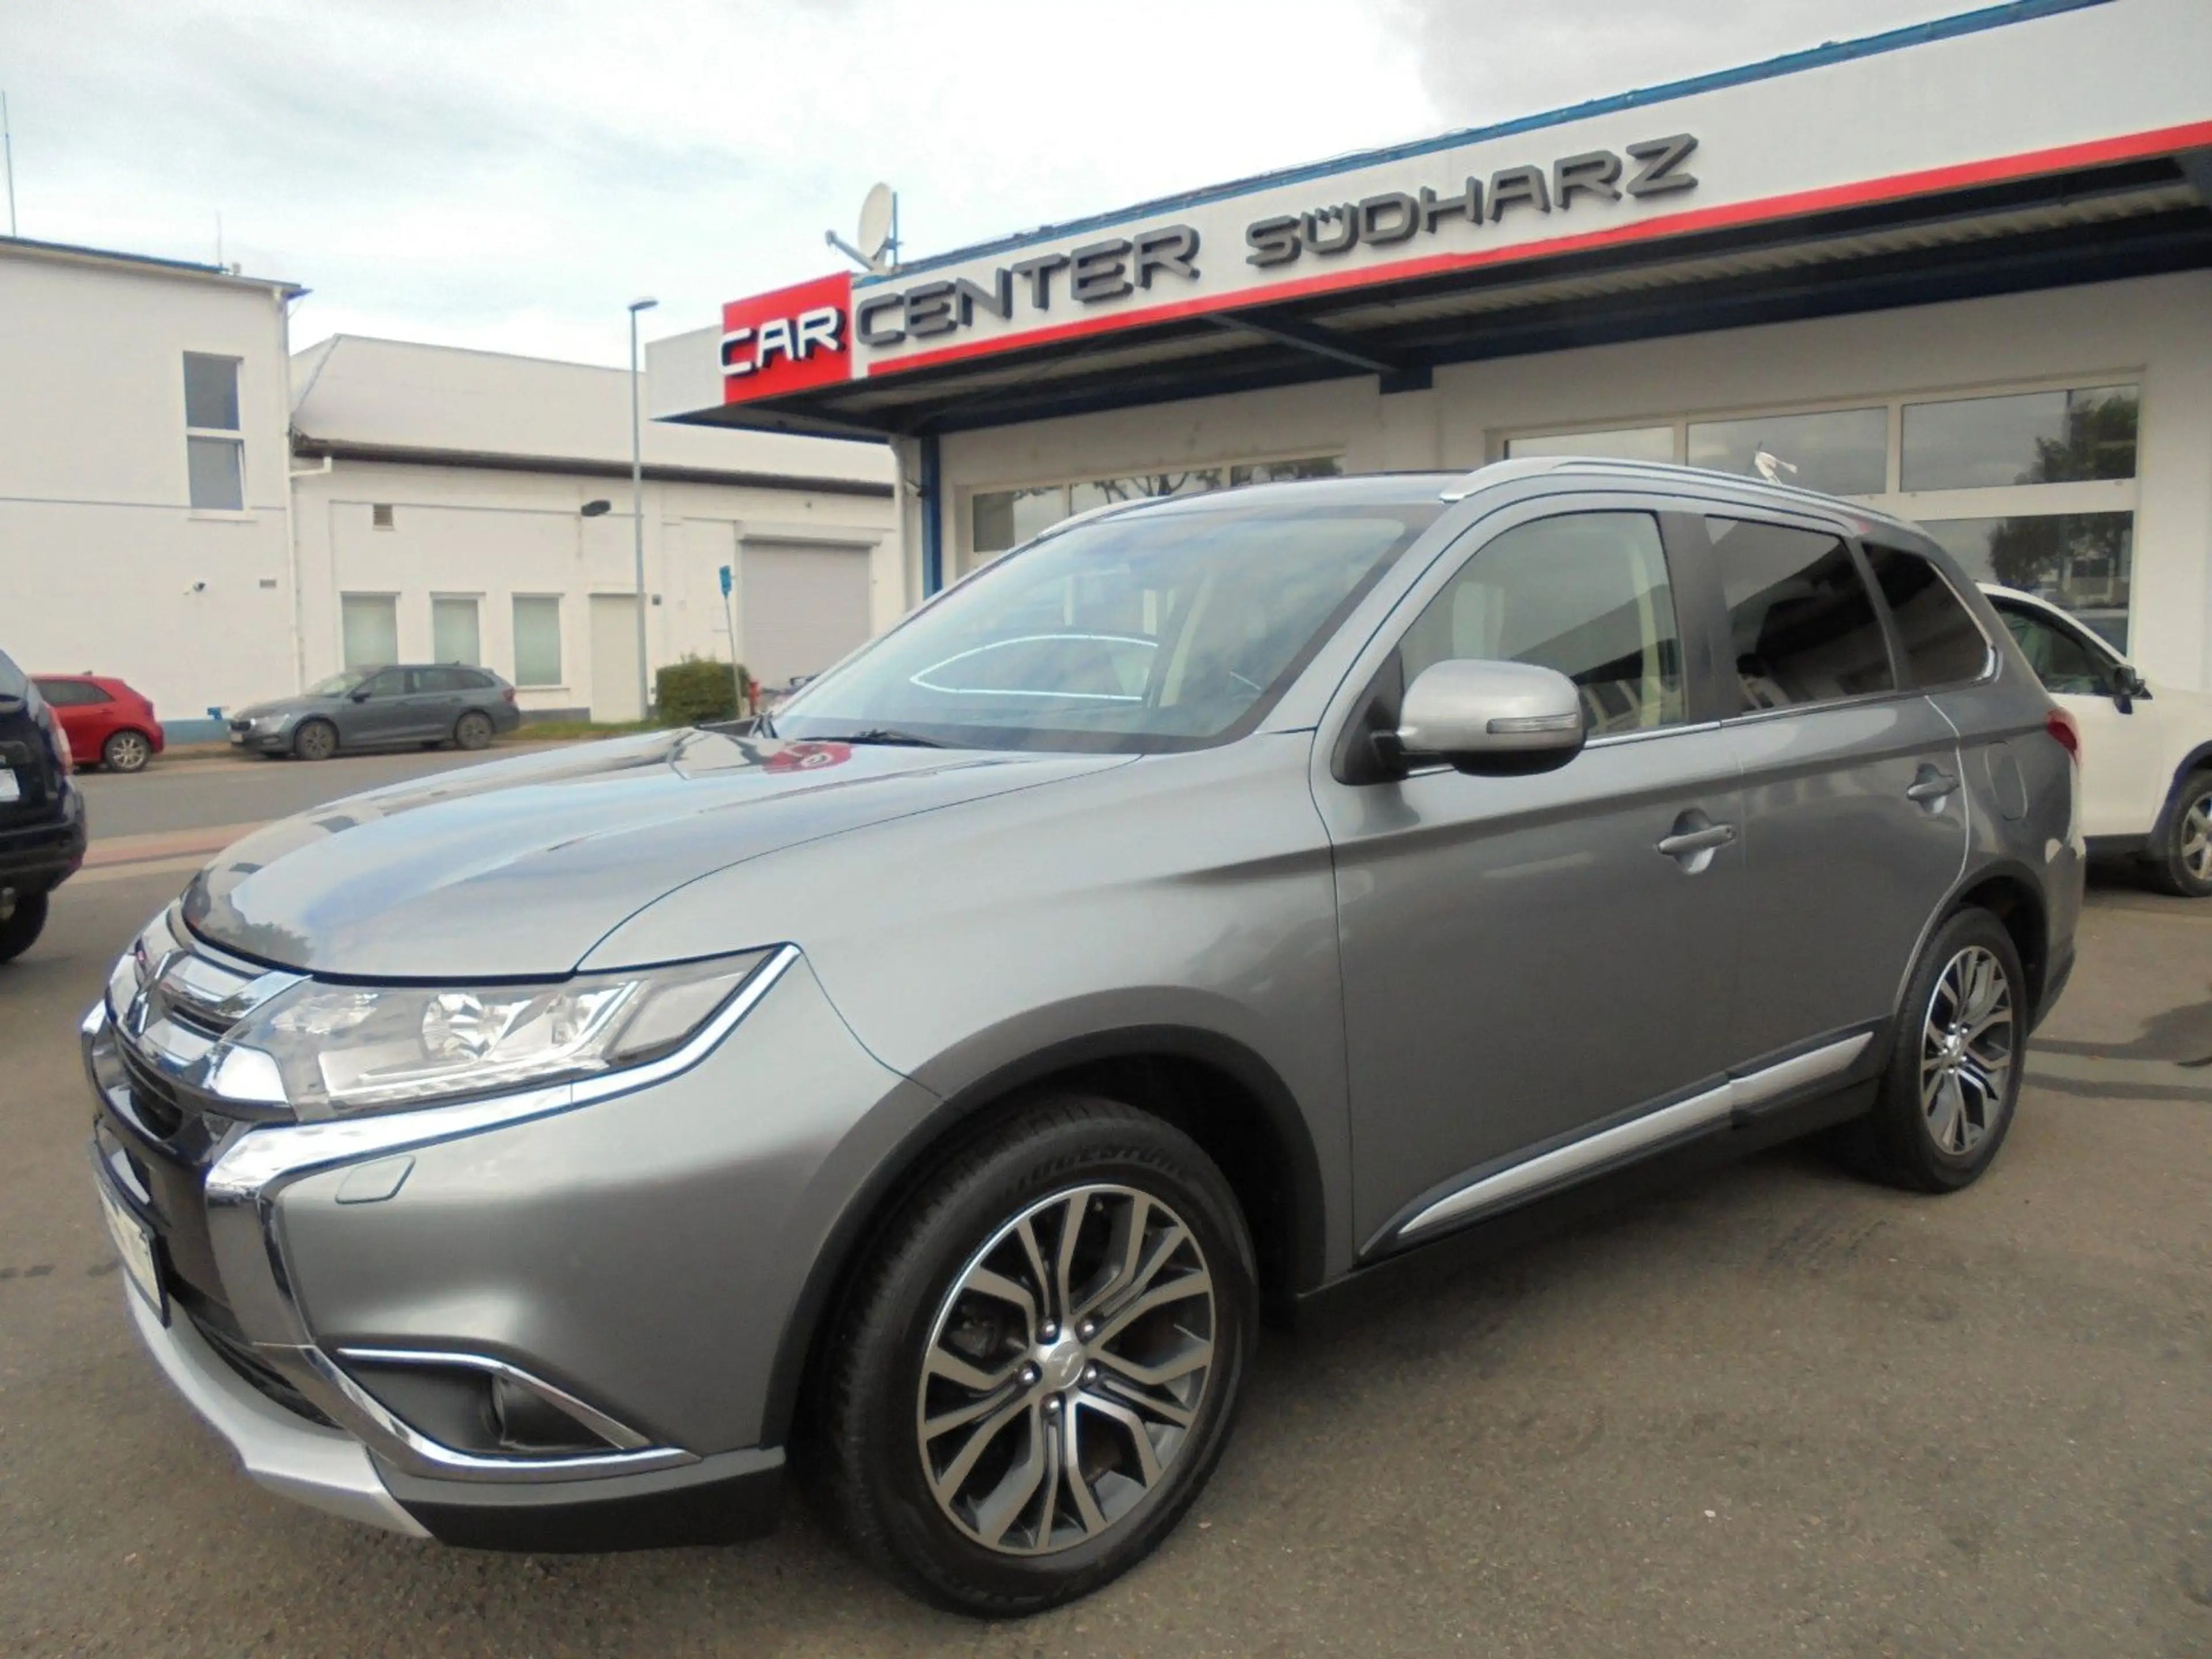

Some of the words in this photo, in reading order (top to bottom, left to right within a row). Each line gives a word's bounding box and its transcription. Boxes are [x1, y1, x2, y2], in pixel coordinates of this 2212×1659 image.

[718, 306, 844, 377] CAR
[856, 224, 1200, 346] CENTER
[1246, 133, 1698, 266] SÜDHARZ
